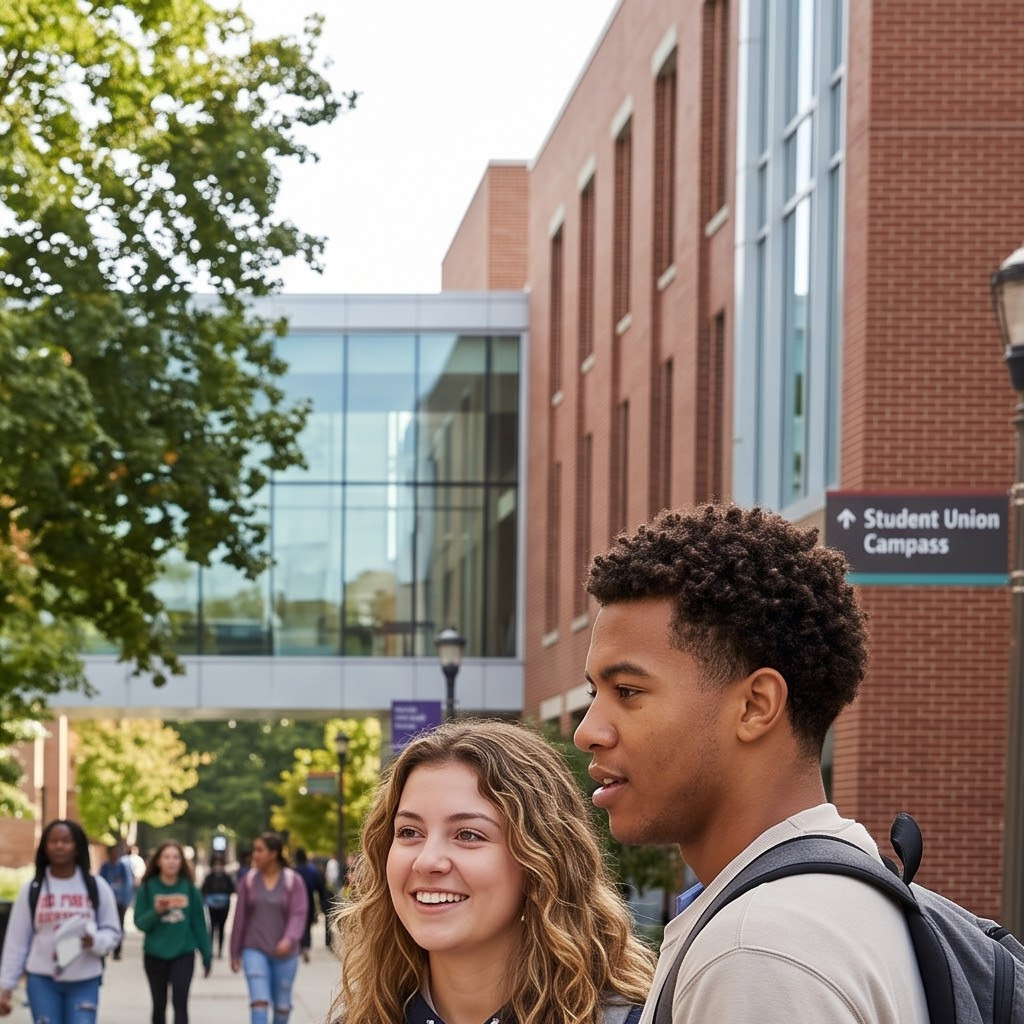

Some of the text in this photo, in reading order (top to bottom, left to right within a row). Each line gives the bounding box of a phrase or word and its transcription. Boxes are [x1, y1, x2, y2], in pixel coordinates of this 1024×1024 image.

[863, 508, 1000, 530] Student Union
[863, 533, 950, 559] Campass
